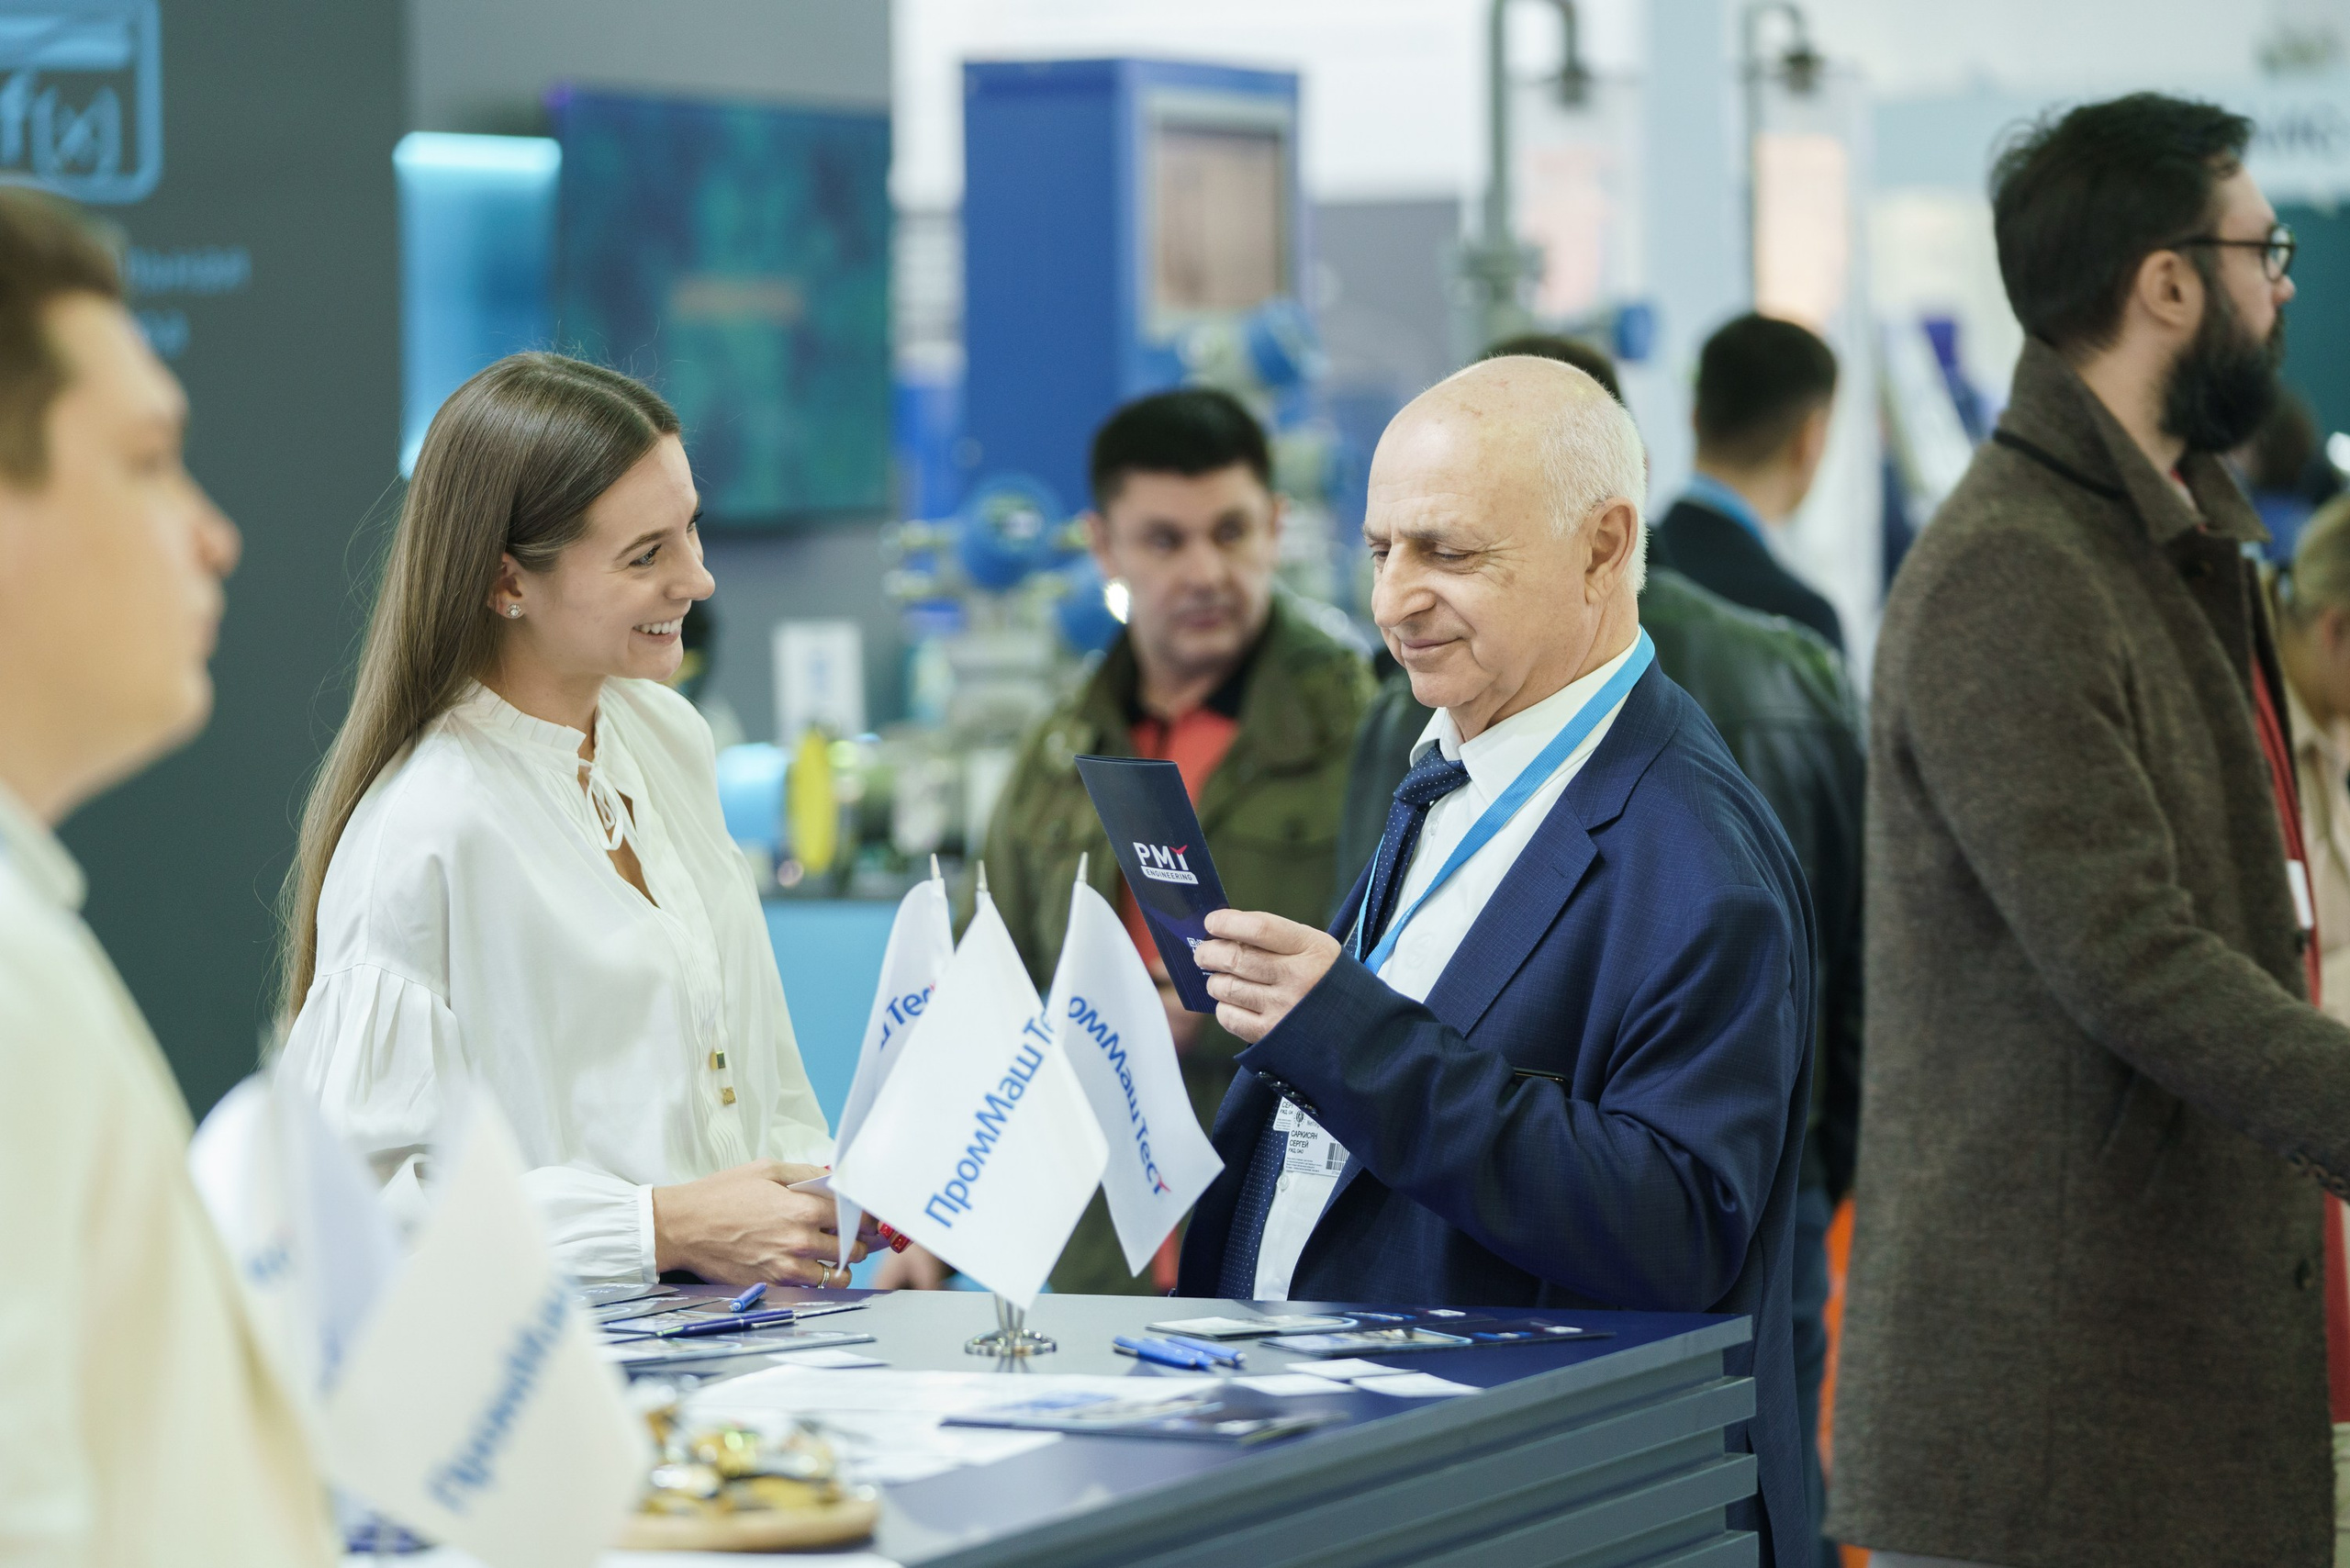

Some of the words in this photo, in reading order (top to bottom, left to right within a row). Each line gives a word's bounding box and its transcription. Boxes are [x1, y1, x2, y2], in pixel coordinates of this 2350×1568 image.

[1133, 842, 1189, 871] PMT
[1146, 868, 1192, 881] ENGINEERING
[1068, 995, 1171, 1195] омМашТест
[1291, 1129, 1318, 1140] САРКИСЯН
[1289, 1139, 1309, 1148] СЕРГЕЙ
